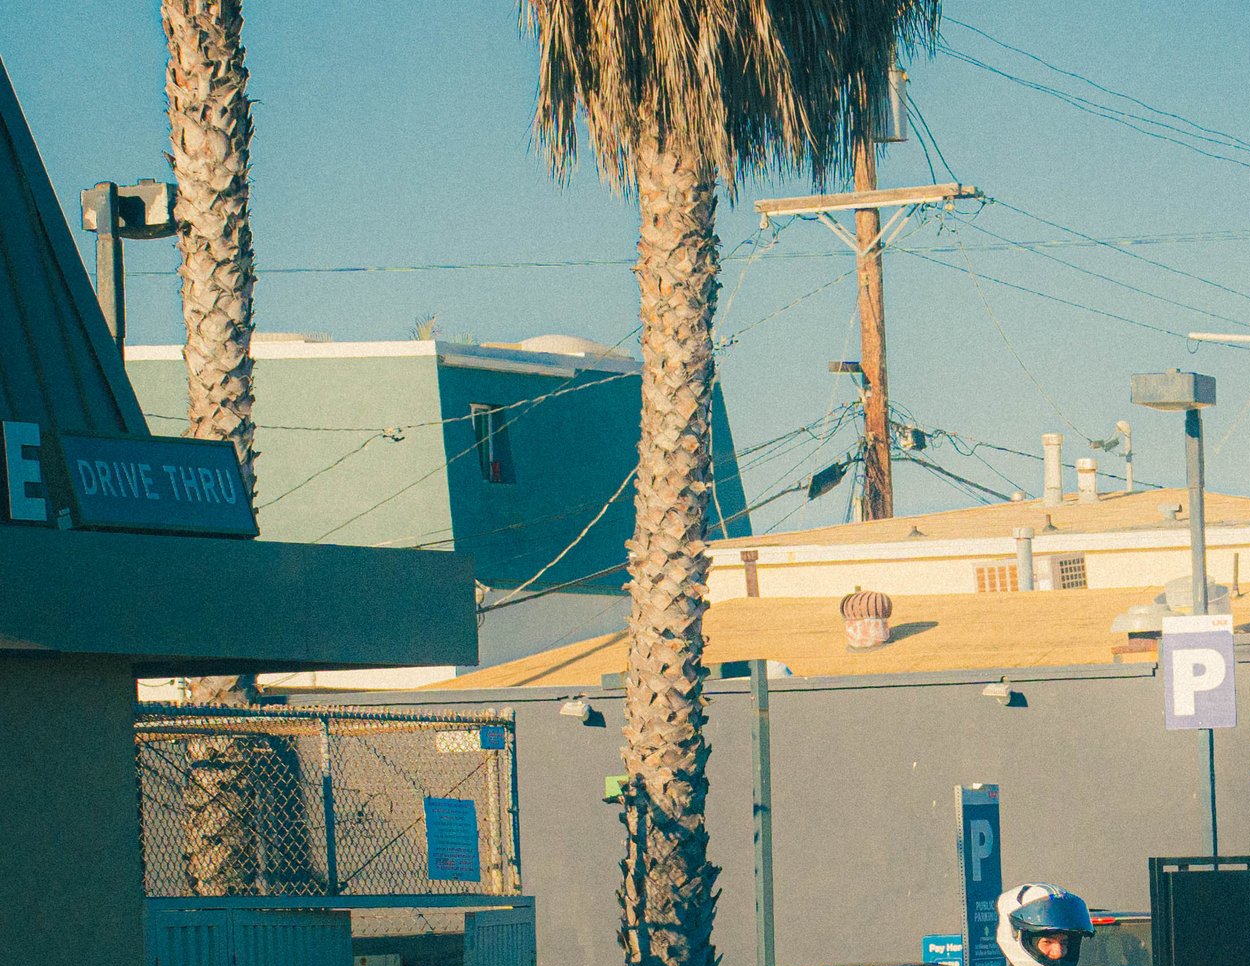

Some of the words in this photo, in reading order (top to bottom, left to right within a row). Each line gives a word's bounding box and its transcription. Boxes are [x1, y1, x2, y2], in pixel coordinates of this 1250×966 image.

[2, 420, 48, 521] E
[77, 459, 160, 500] DRIVE
[163, 464, 237, 505] THRU
[1172, 648, 1226, 716] P
[970, 819, 994, 882] P
[928, 943, 946, 954] Pay
